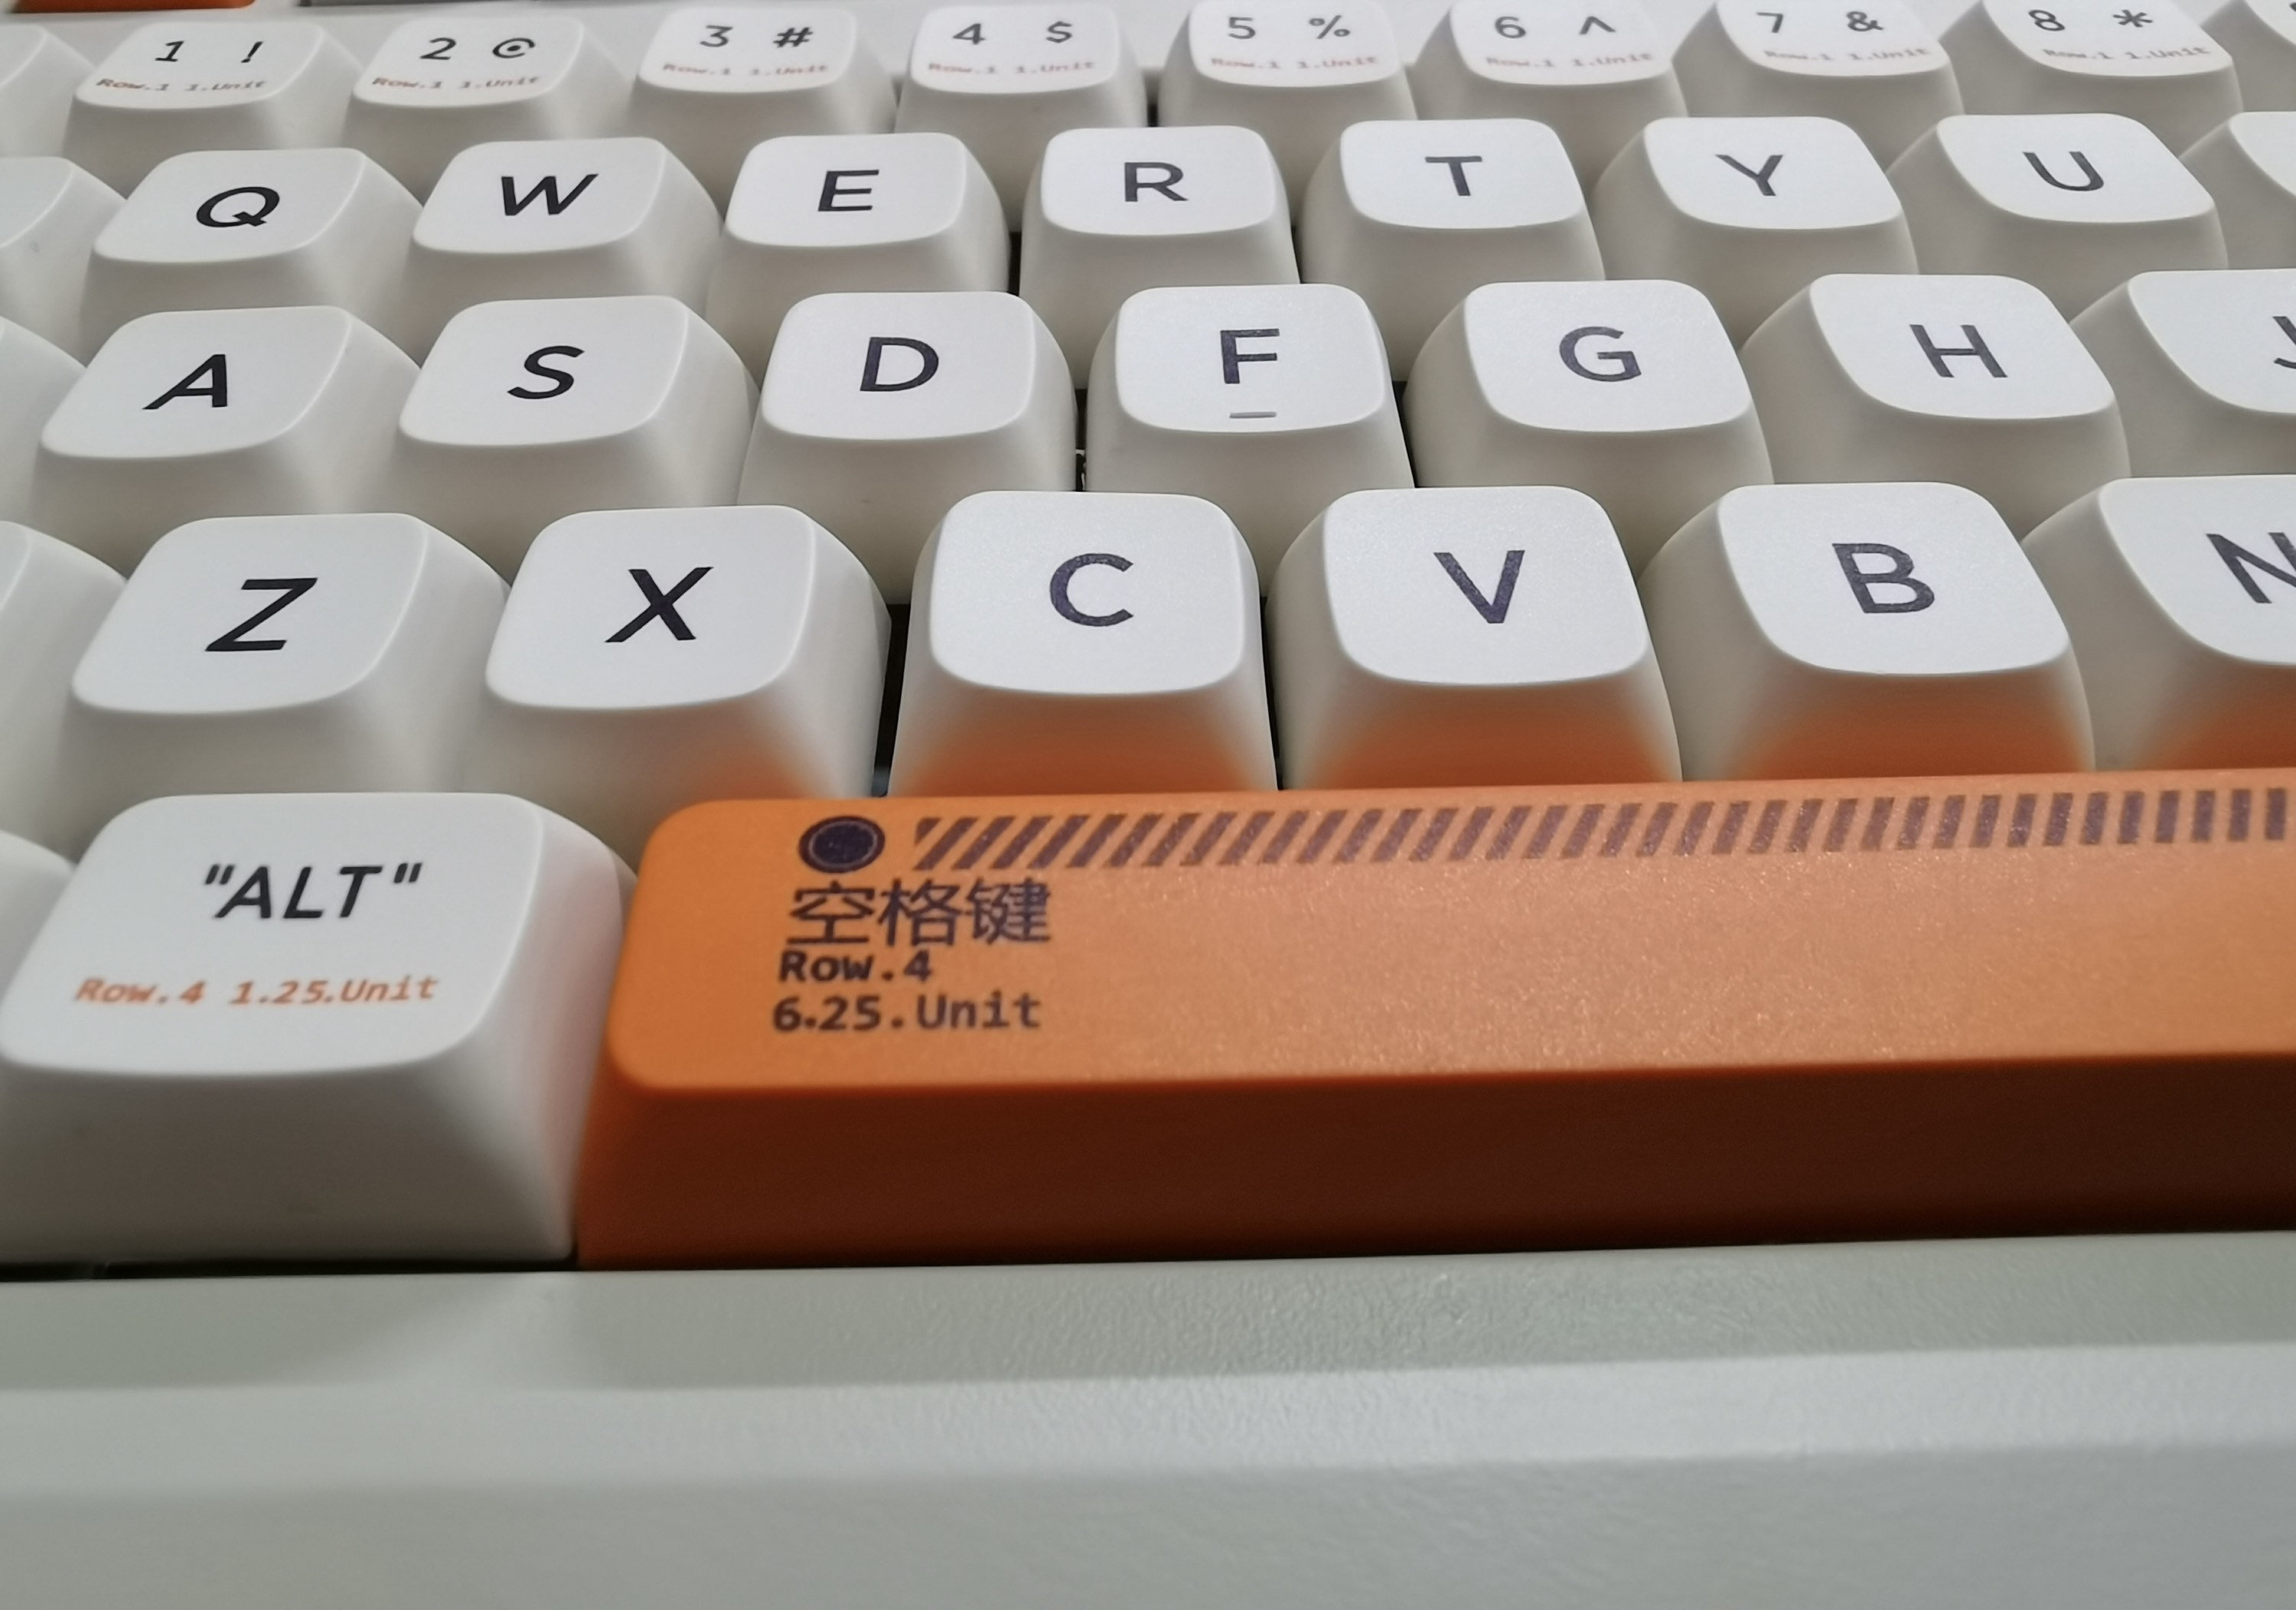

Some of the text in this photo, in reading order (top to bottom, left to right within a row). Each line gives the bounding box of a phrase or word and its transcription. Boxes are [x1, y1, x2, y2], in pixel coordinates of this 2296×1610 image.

[700, 24, 813, 48] 3 #
[953, 21, 1073, 45] 4 $
[1228, 15, 1351, 40] 5 %
[1494, 15, 1527, 39] 6
[1757, 11, 1883, 34] 7 &
[2028, 9, 2066, 32] 8
[155, 41, 263, 64] 1 !
[419, 37, 457, 60] 2
[95, 77, 170, 92] Row.1
[370, 77, 443, 90] Row.1
[817, 169, 879, 212] E
[1124, 161, 1188, 203] R
[1424, 155, 1483, 197] T
[1716, 154, 1783, 197] Y
[2023, 151, 2105, 192] U
[196, 186, 280, 228] Q
[501, 173, 598, 217] W
[507, 345, 585, 400] S
[859, 336, 940, 393] D
[1219, 328, 1280, 385] F
[1558, 326, 1642, 383] G
[1909, 324, 2008, 379] H
[142, 354, 228, 410] A
[1049, 552, 1134, 627] C
[1433, 549, 1526, 624] V
[1831, 543, 1936, 614] B
[2206, 532, 2296, 605] N
[204, 577, 318, 653] Z
[605, 566, 714, 644] X
[204, 862, 422, 920] "ALT"
[787, 878, 1050, 947] 空格键
[778, 948, 932, 983] Row.4
[76, 975, 438, 1005] Row.4 1.25.Unit
[772, 990, 1040, 1033] 6.25.Unit
